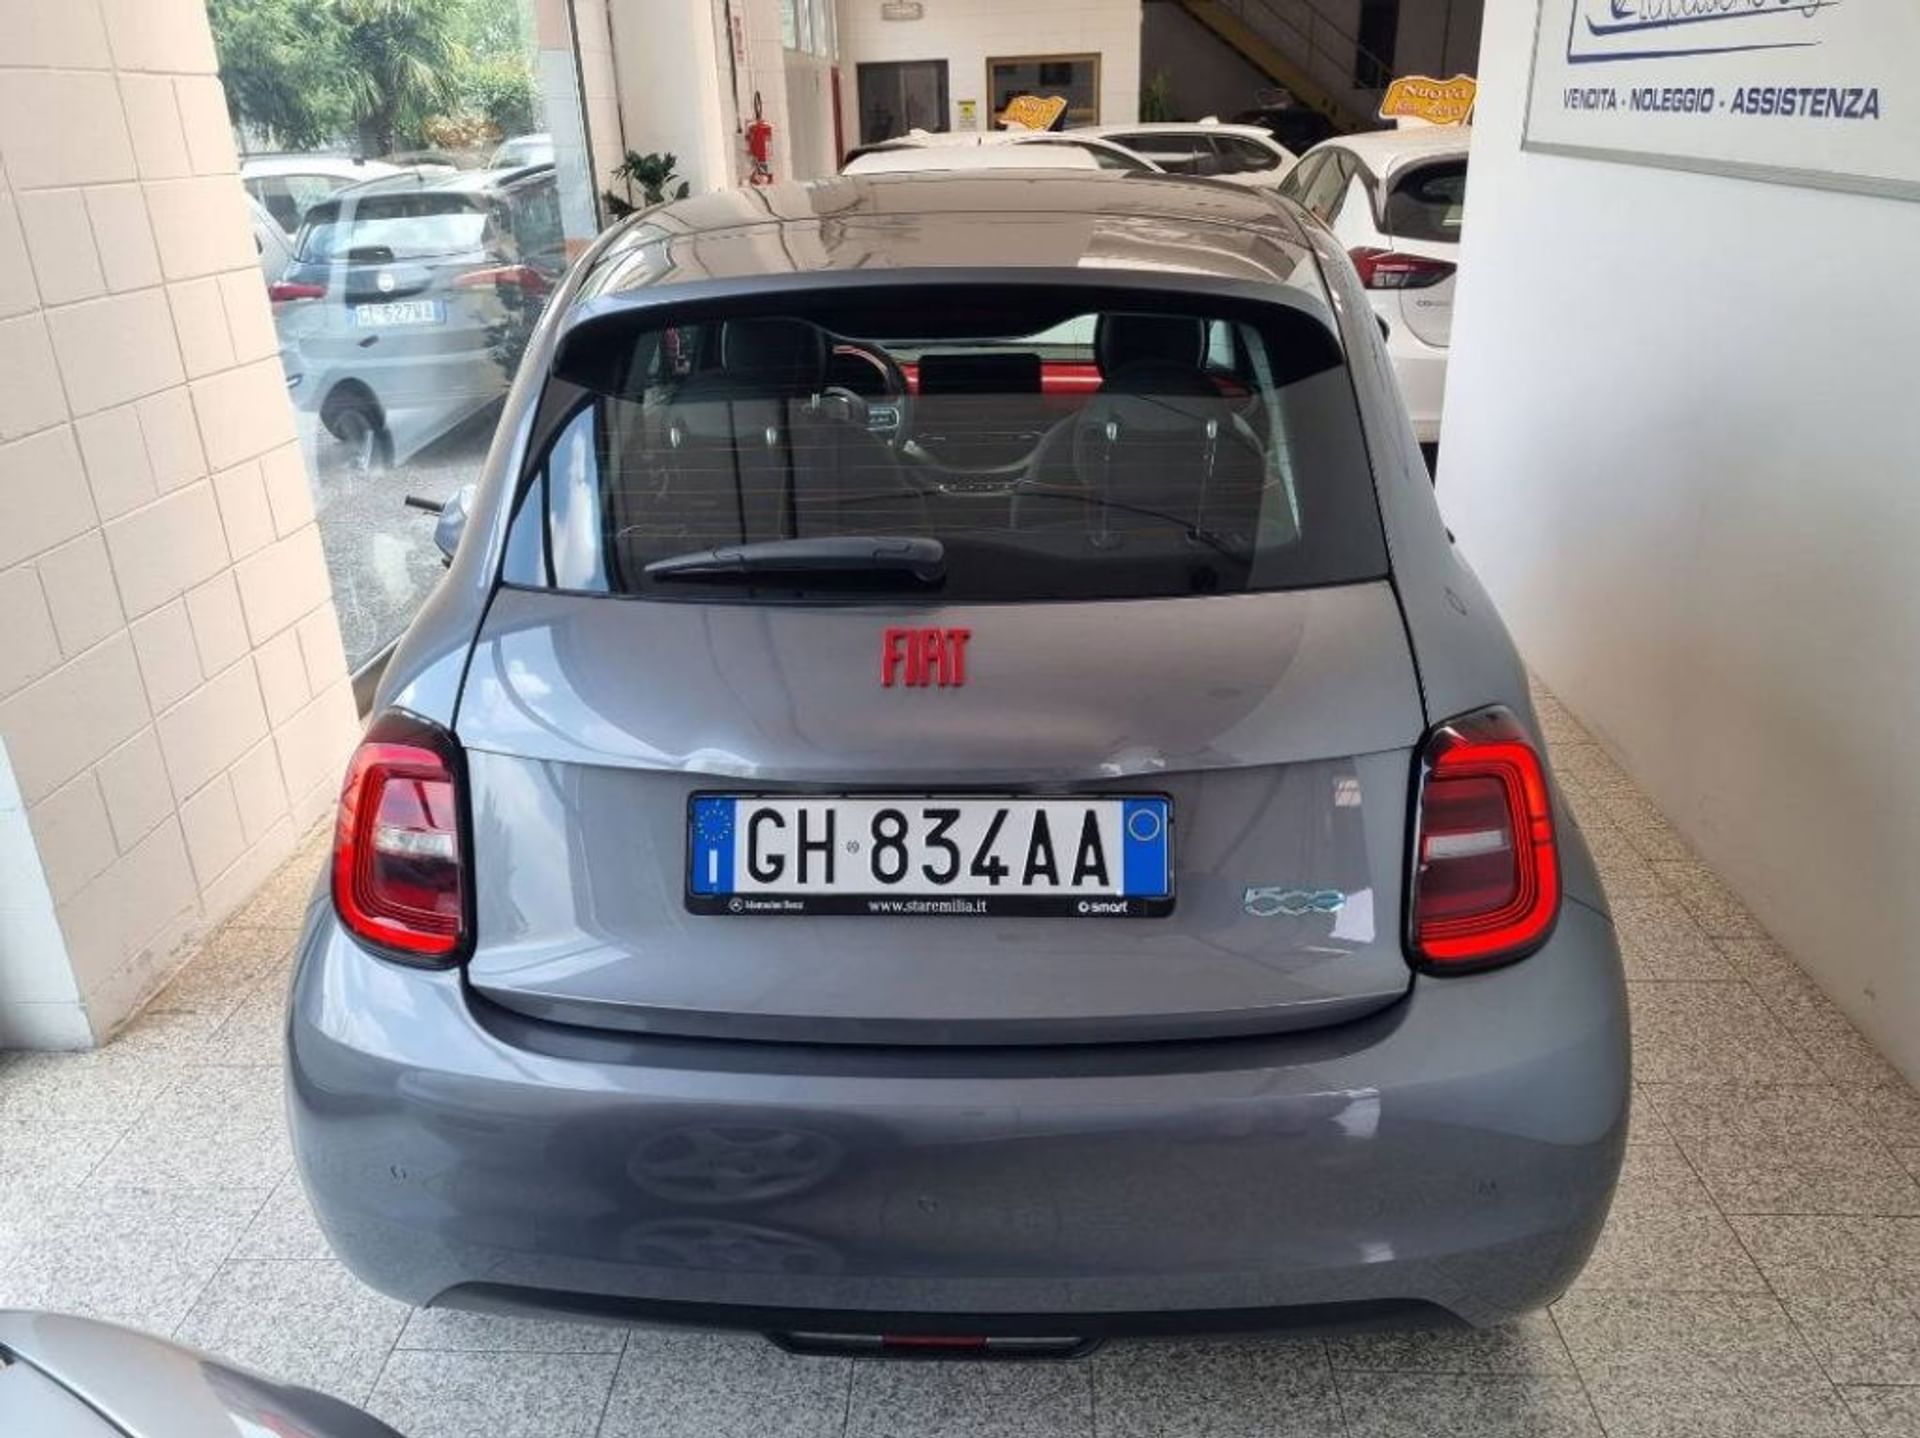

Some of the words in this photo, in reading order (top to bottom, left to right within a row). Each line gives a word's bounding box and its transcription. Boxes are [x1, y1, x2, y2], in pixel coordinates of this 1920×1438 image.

[1402, 85, 1466, 100] Nuova
[1563, 87, 1617, 111] VENDITA
[1629, 87, 1715, 113] NOLEGGIO
[1730, 87, 1881, 120] ASSISTENZA
[881, 627, 972, 688] FIAT
[747, 807, 836, 885] GH
[870, 807, 1110, 887] 834AA
[868, 897, 988, 915] www.staremilia.it
[1091, 901, 1128, 914] smart
